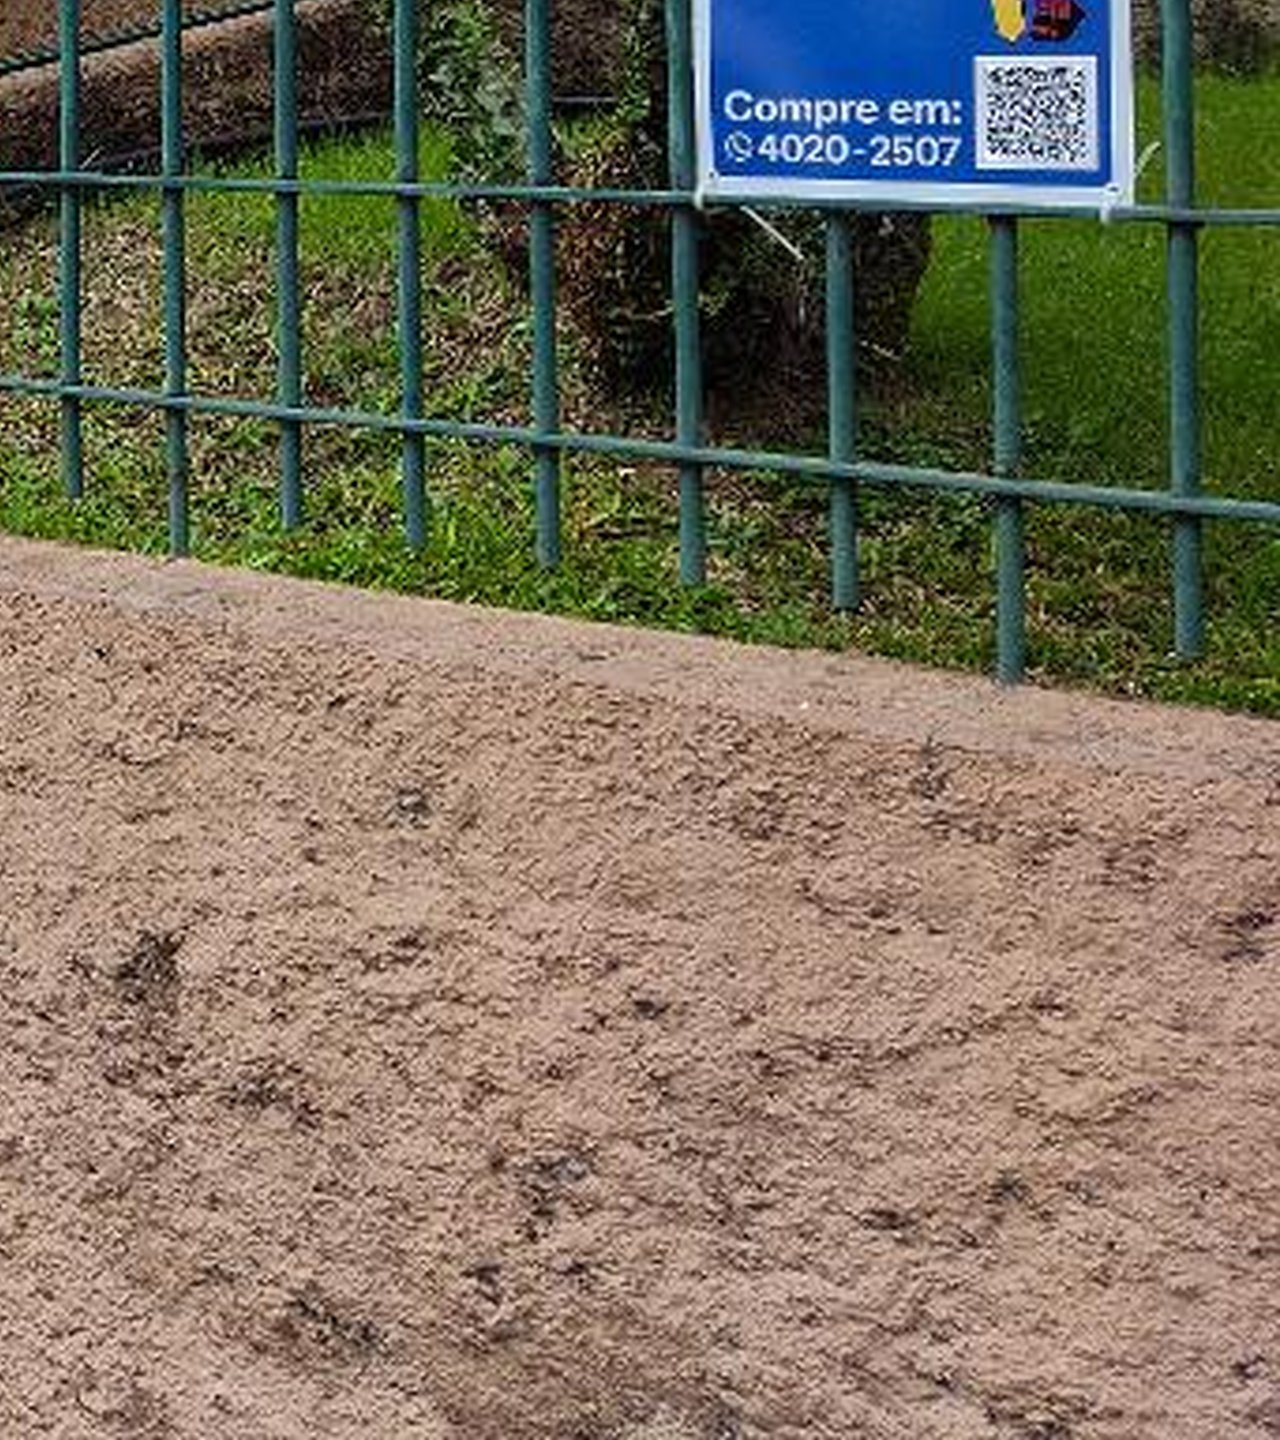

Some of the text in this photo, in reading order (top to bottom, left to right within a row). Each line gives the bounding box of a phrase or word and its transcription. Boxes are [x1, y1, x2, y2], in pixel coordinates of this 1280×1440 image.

[723, 90, 962, 130] Compre em:
[757, 133, 962, 167] 4020-2507
